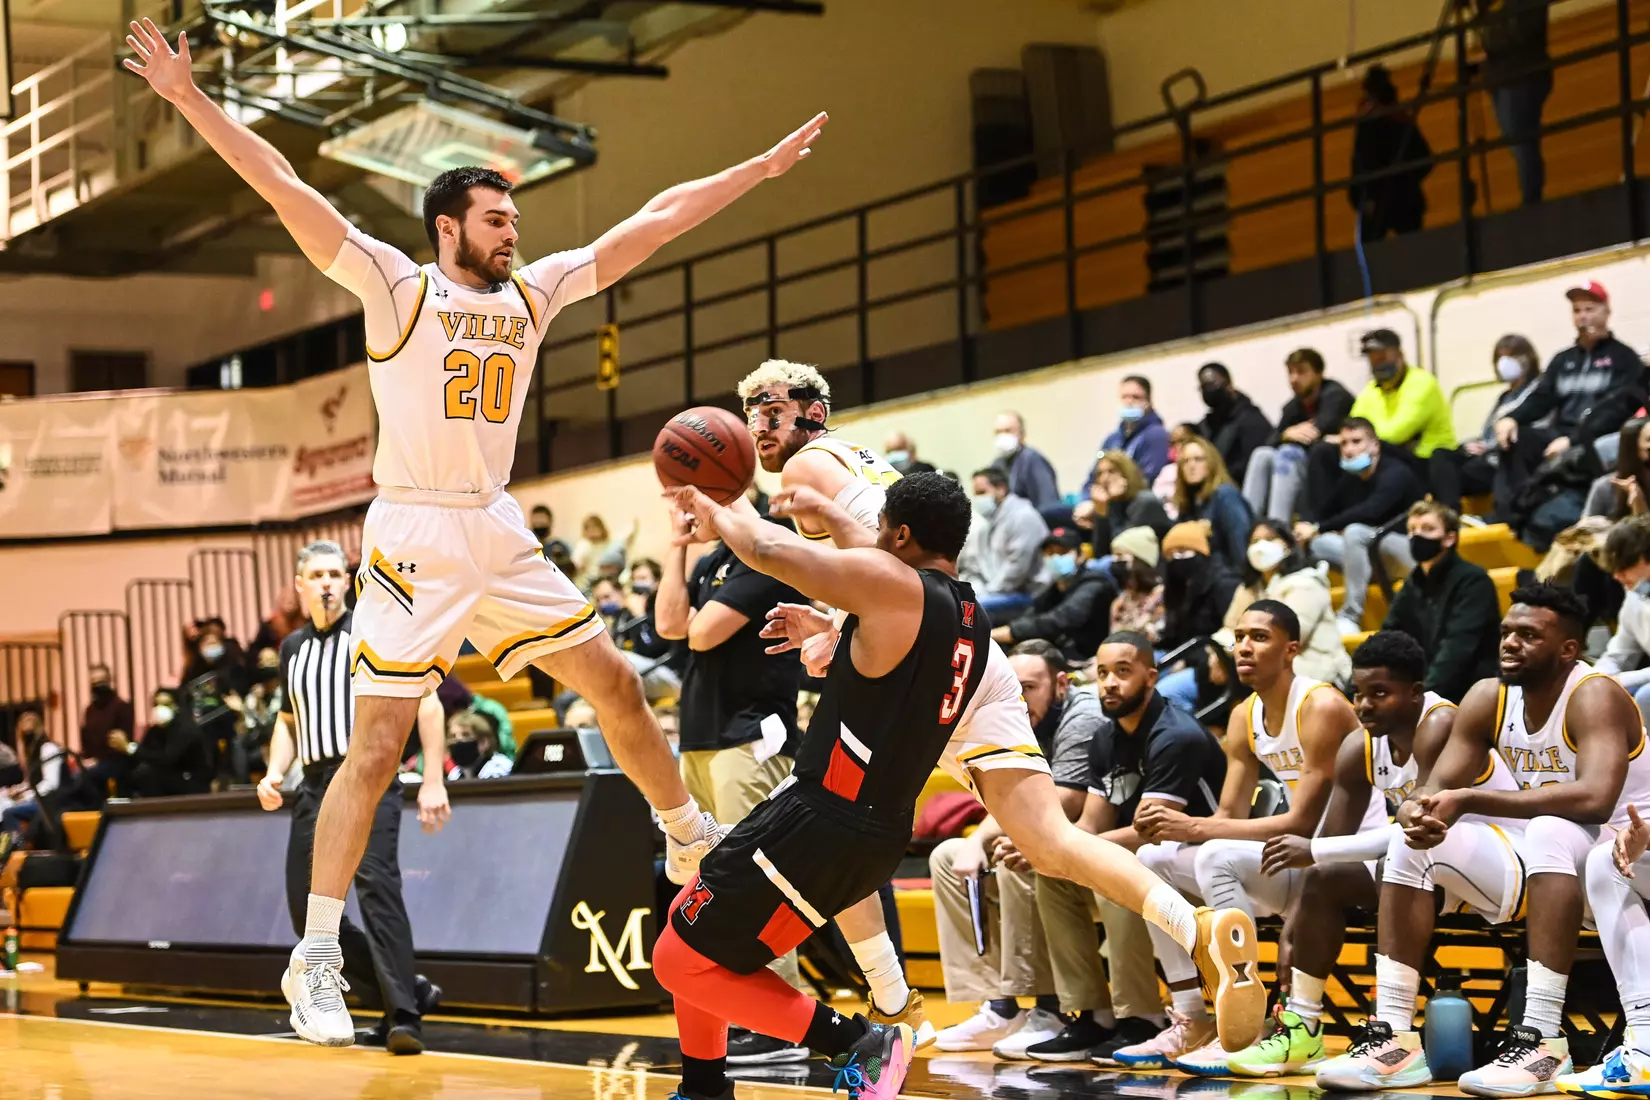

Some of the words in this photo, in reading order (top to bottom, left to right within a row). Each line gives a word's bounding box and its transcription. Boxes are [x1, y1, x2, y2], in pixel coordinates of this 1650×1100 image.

[438, 311, 528, 350] VILLE
[444, 349, 516, 424] 20
[158, 444, 288, 462] Northwestern
[674, 413, 727, 454] Wilson
[158, 464, 227, 484] Mutual
[660, 438, 702, 472] NCAA
[939, 637, 975, 725] 3
[571, 900, 653, 990] M
